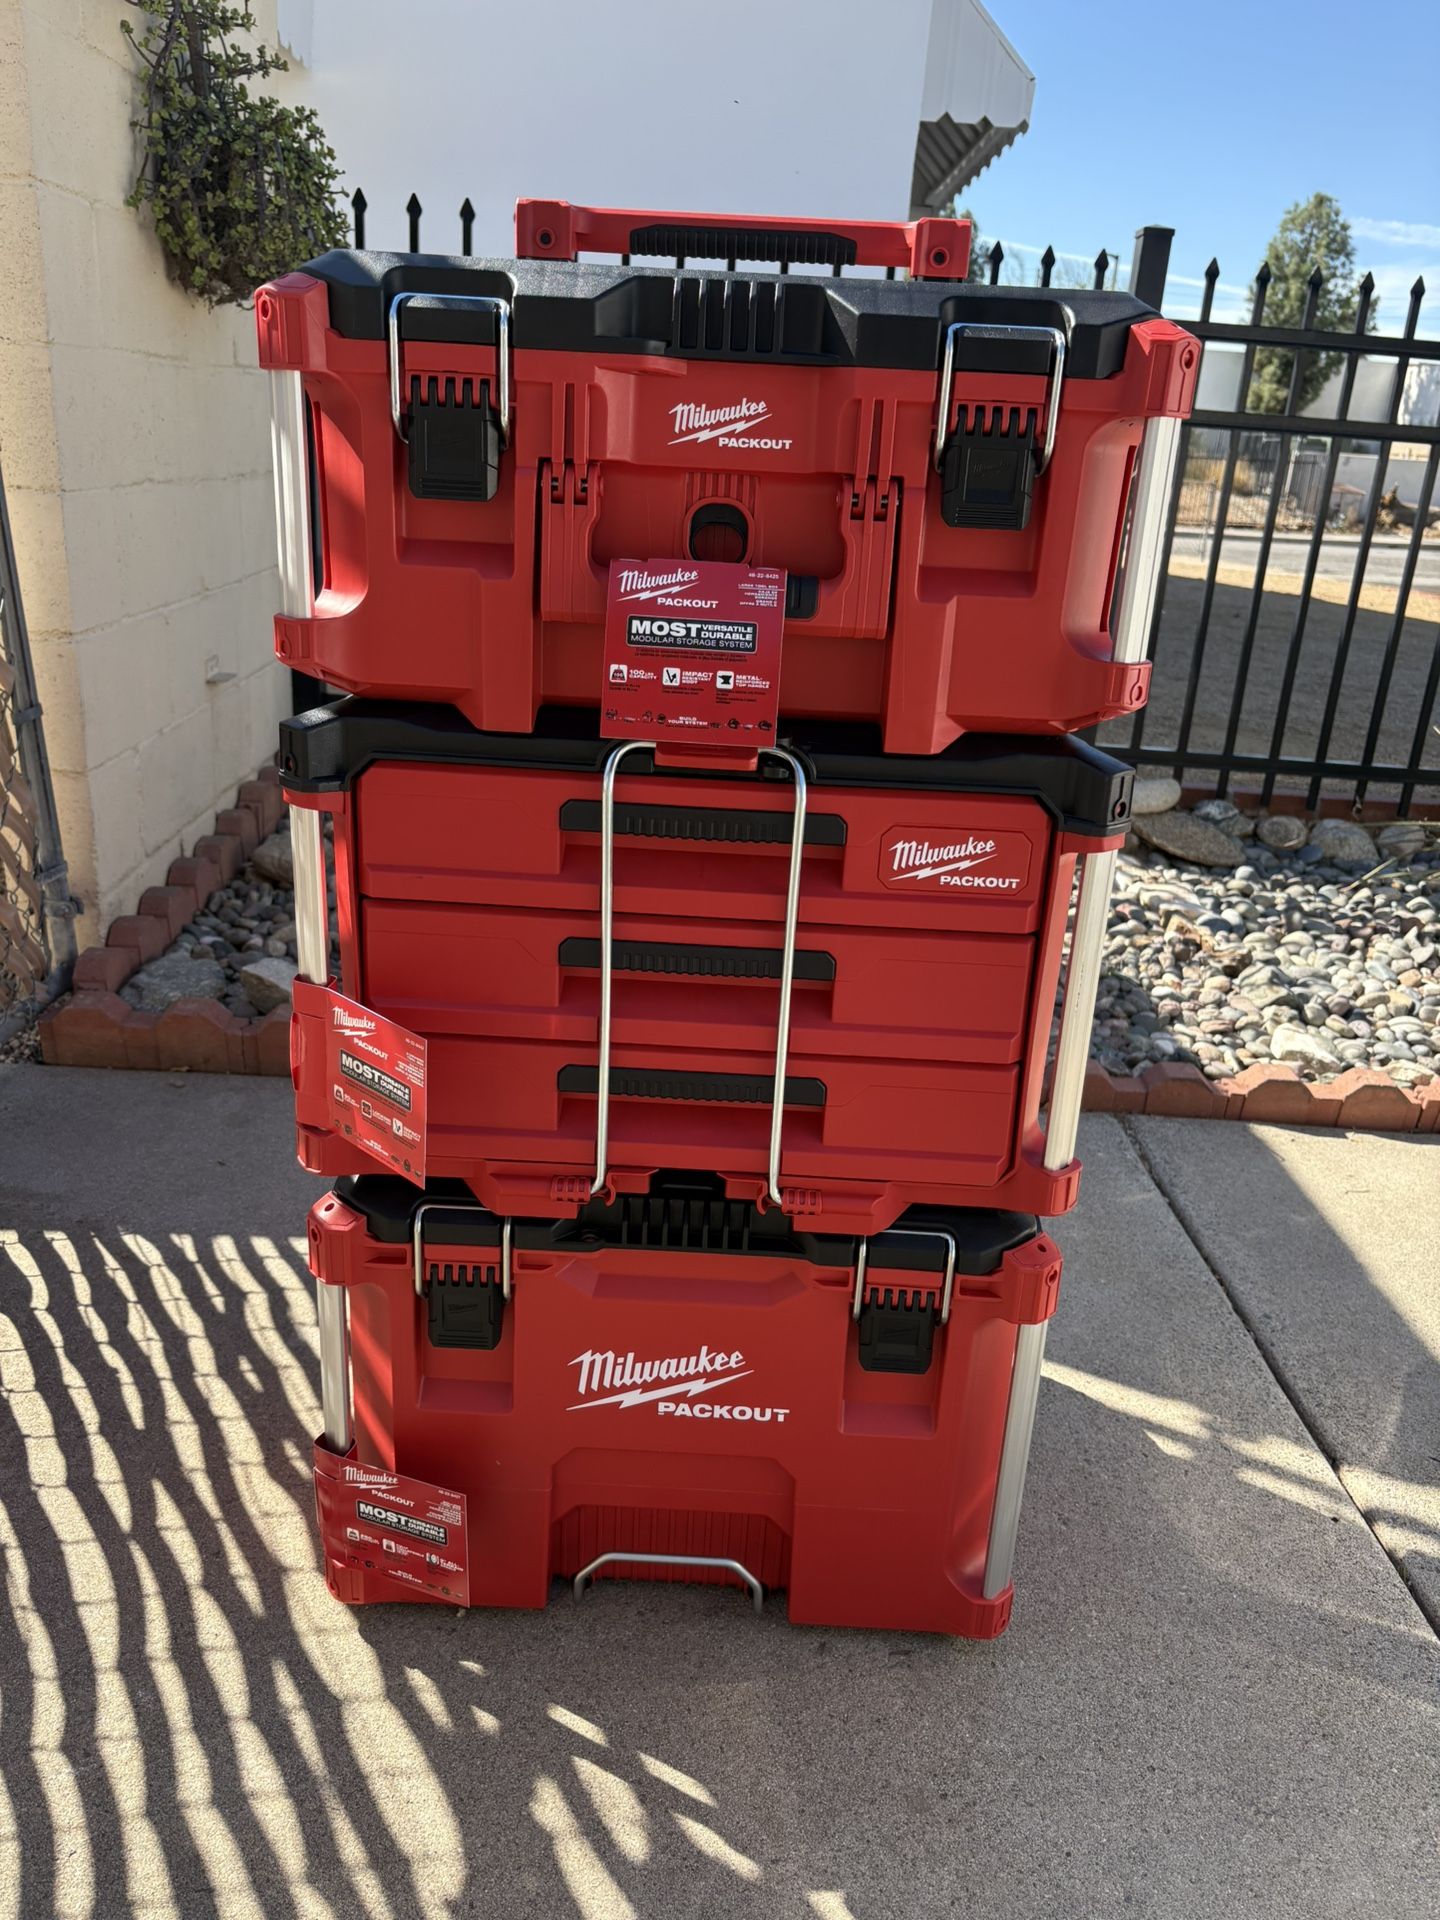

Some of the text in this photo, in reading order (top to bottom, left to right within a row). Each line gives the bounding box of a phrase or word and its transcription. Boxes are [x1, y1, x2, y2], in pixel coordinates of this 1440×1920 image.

[668, 398, 768, 434] Milwaukee
[718, 437, 793, 450] PACKOUT
[616, 568, 699, 593] Milwaukee
[657, 597, 719, 609] PACKOUT
[631, 619, 702, 638] MOST
[701, 631, 753, 641] DURABLE
[702, 624, 753, 633] VERSATILE
[630, 635, 753, 649] MODULAR STORAGE SYSTEM
[888, 837, 997, 871] Milwaukee
[940, 875, 1020, 889] PACKOUT
[332, 1006, 377, 1029] Milwaukee
[353, 1037, 389, 1061] PACKOUT
[341, 1053, 381, 1083] MOST
[342, 1065, 367, 1082] MODULAR
[367, 1079, 390, 1097] STORAGE
[390, 1091, 410, 1108] SYSTEM
[380, 1080, 410, 1101] DURABLE
[567, 1345, 747, 1395] Milwaukee
[657, 1402, 790, 1422] PACKOUT
[342, 1465, 400, 1485] Milwaukee
[371, 1489, 415, 1508] PACKOUT
[359, 1503, 409, 1526] MOST
[359, 1512, 446, 1544] MODULAR STORAGE SYSTEM
[408, 1517, 445, 1533] VERSATILE
[408, 1522, 445, 1538] DURABLE
